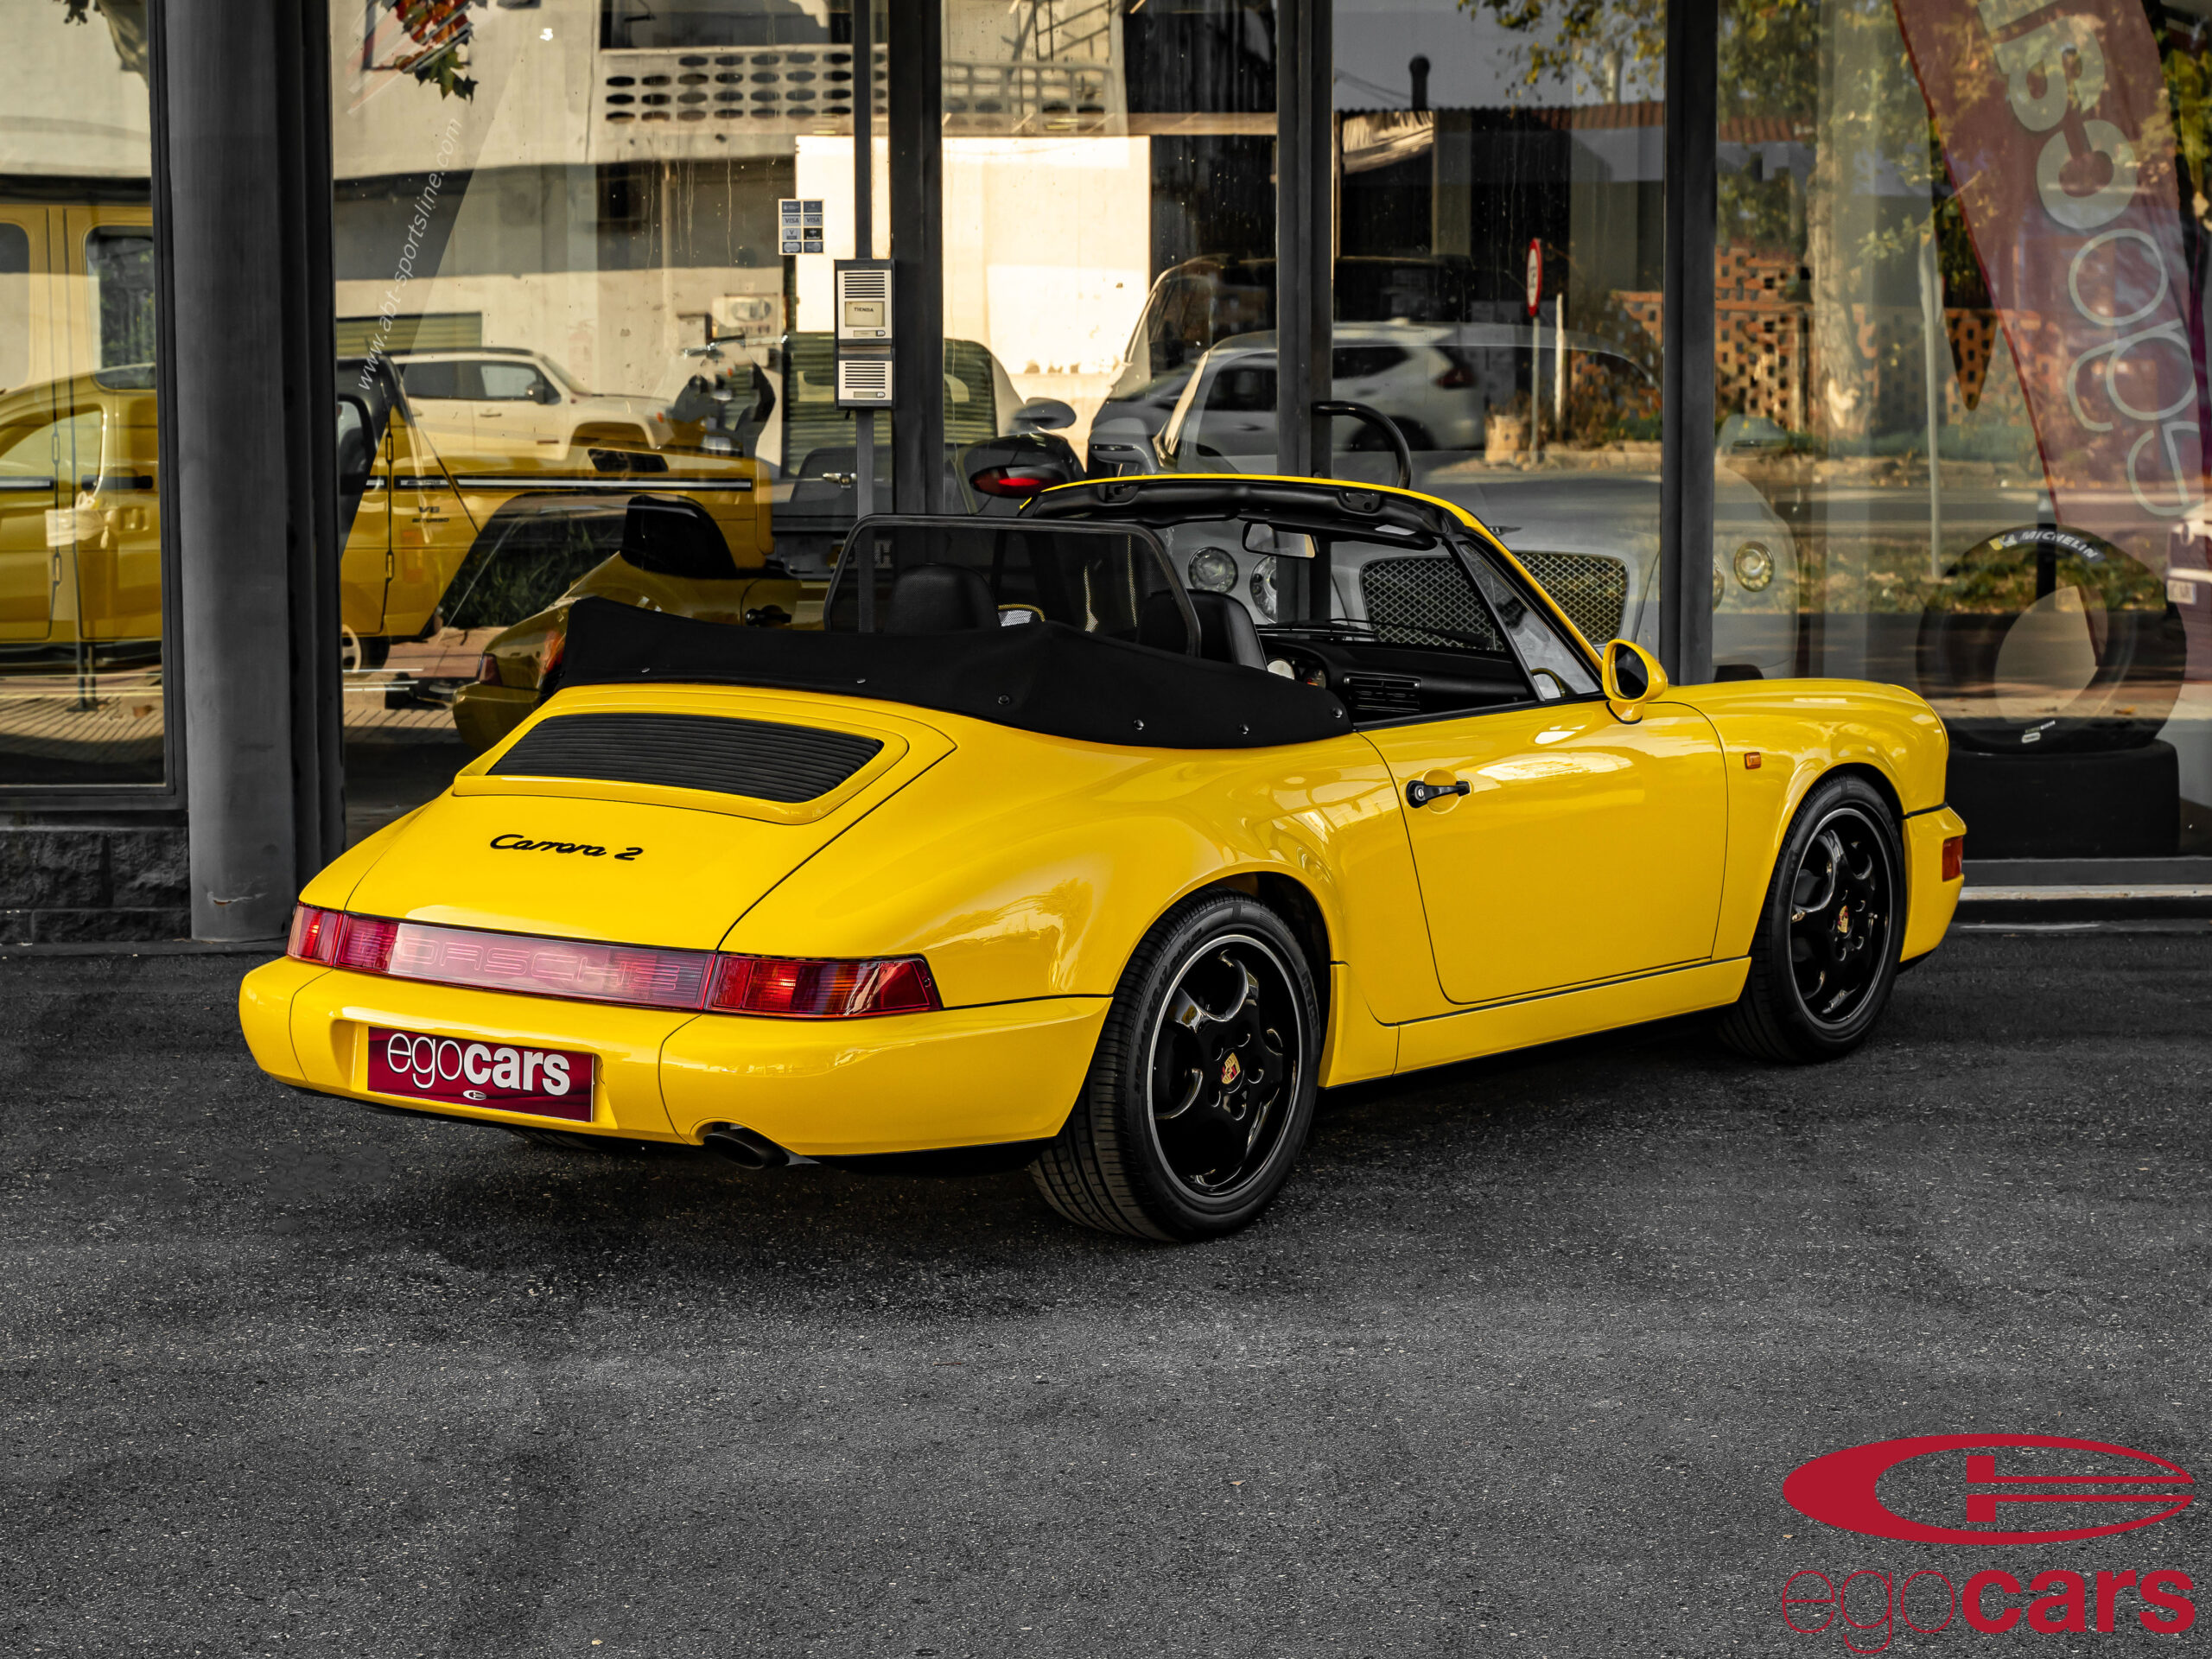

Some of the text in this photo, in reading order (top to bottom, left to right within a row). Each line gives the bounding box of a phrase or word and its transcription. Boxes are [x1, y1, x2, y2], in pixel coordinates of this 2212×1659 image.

[358, 118, 462, 391] www.abt-sportsline.com
[2020, 531, 2098, 558] MICHELIN
[614, 847, 643, 861] 2
[387, 1033, 570, 1096] egocars
